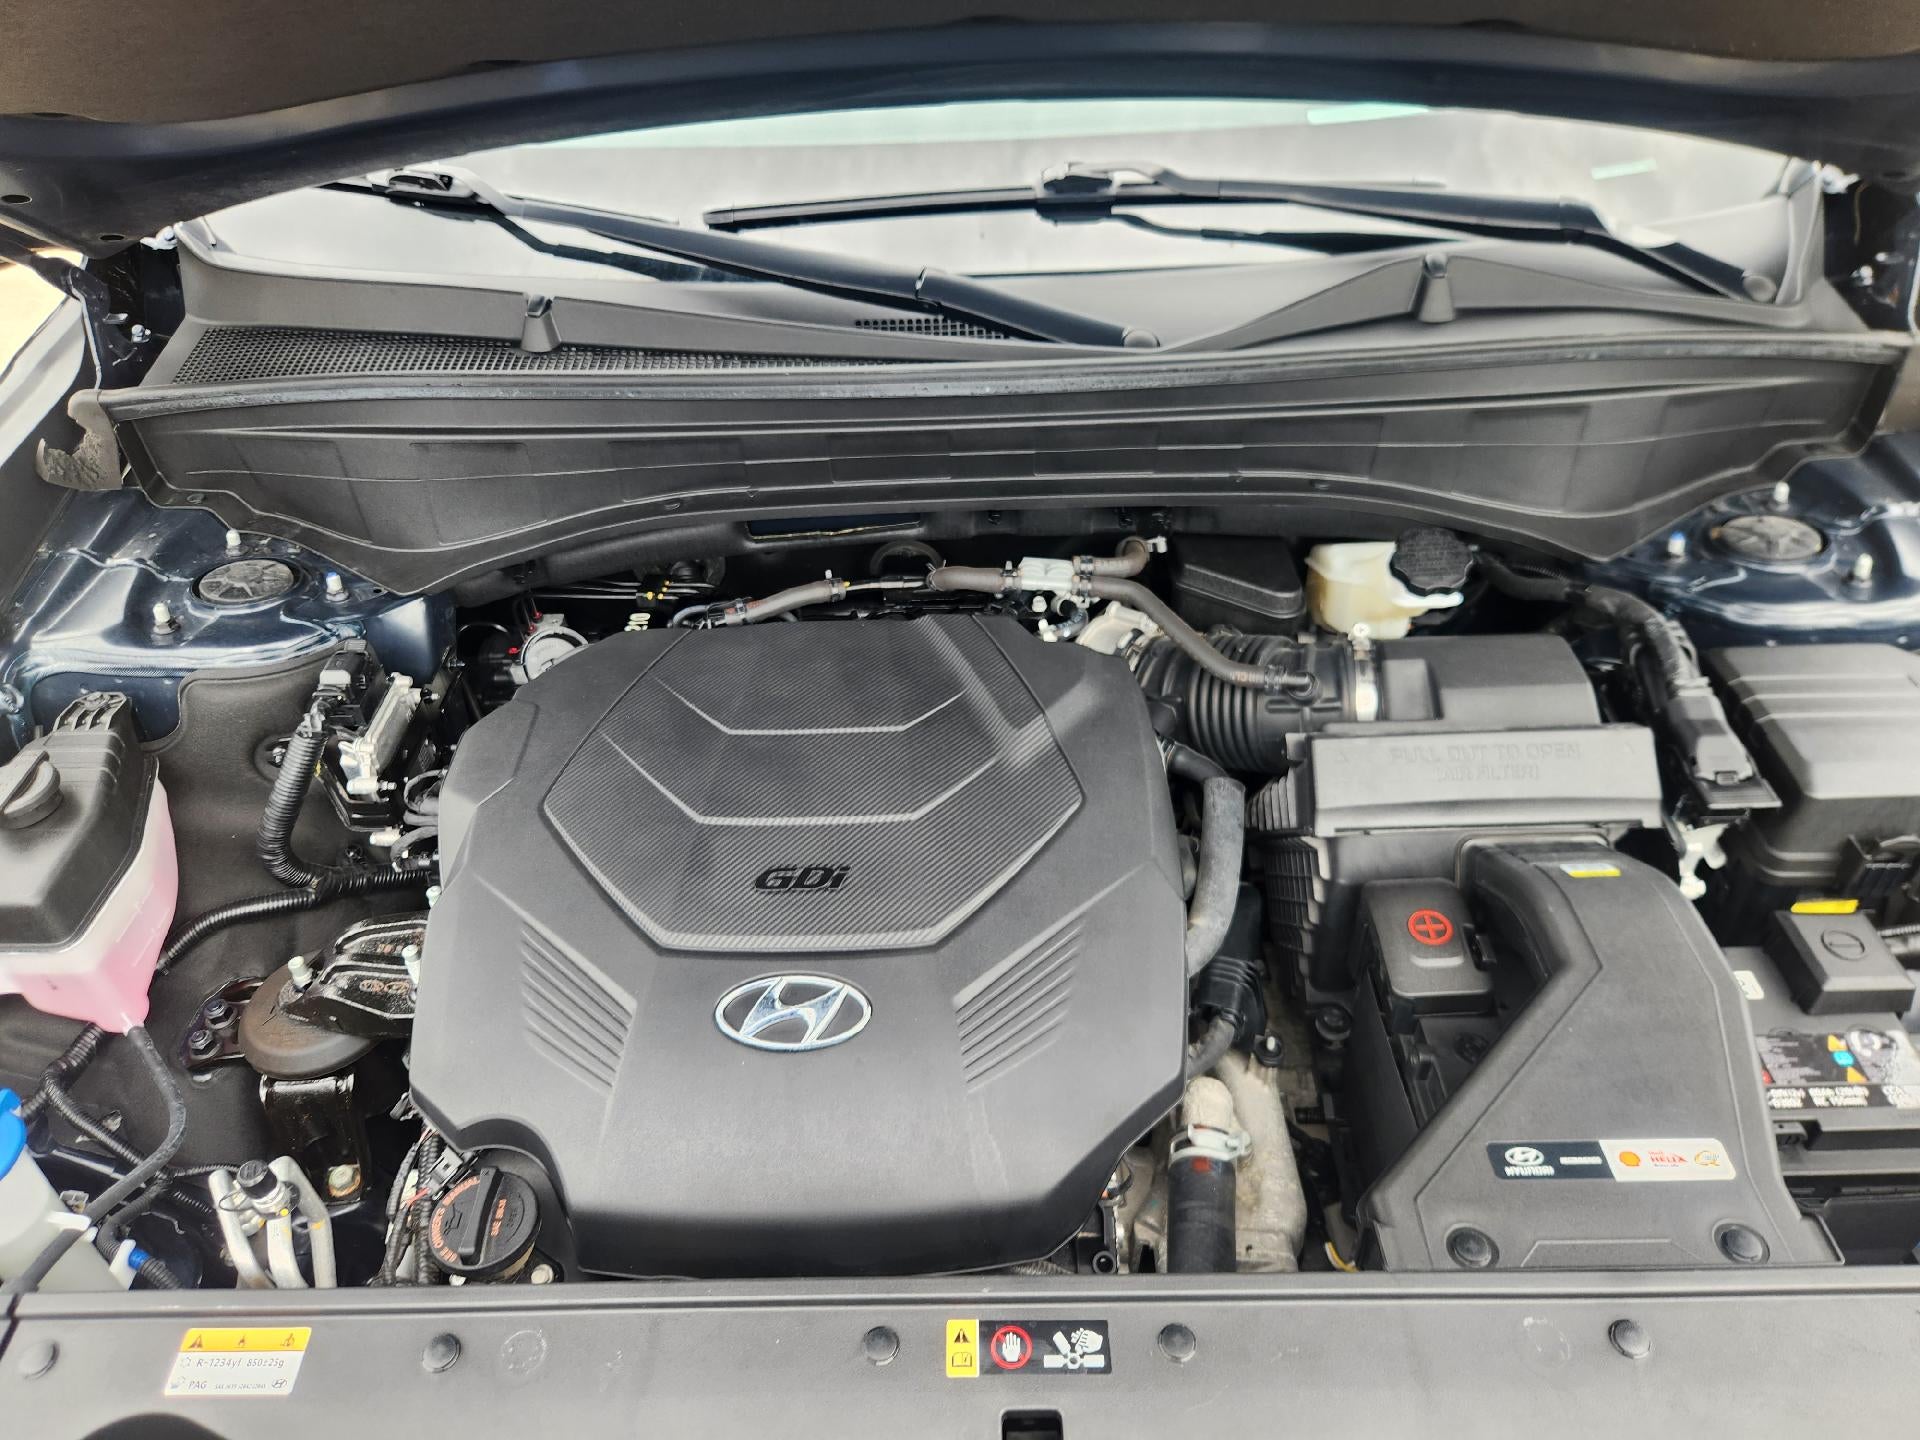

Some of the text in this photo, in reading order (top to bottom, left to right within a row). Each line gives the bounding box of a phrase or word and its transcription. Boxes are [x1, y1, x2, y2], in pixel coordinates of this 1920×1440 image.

[1389, 742, 1582, 764] PULL OUT TO OPEN
[196, 1358, 243, 1369] R-1234yf
[188, 1380, 208, 1390] PAG
